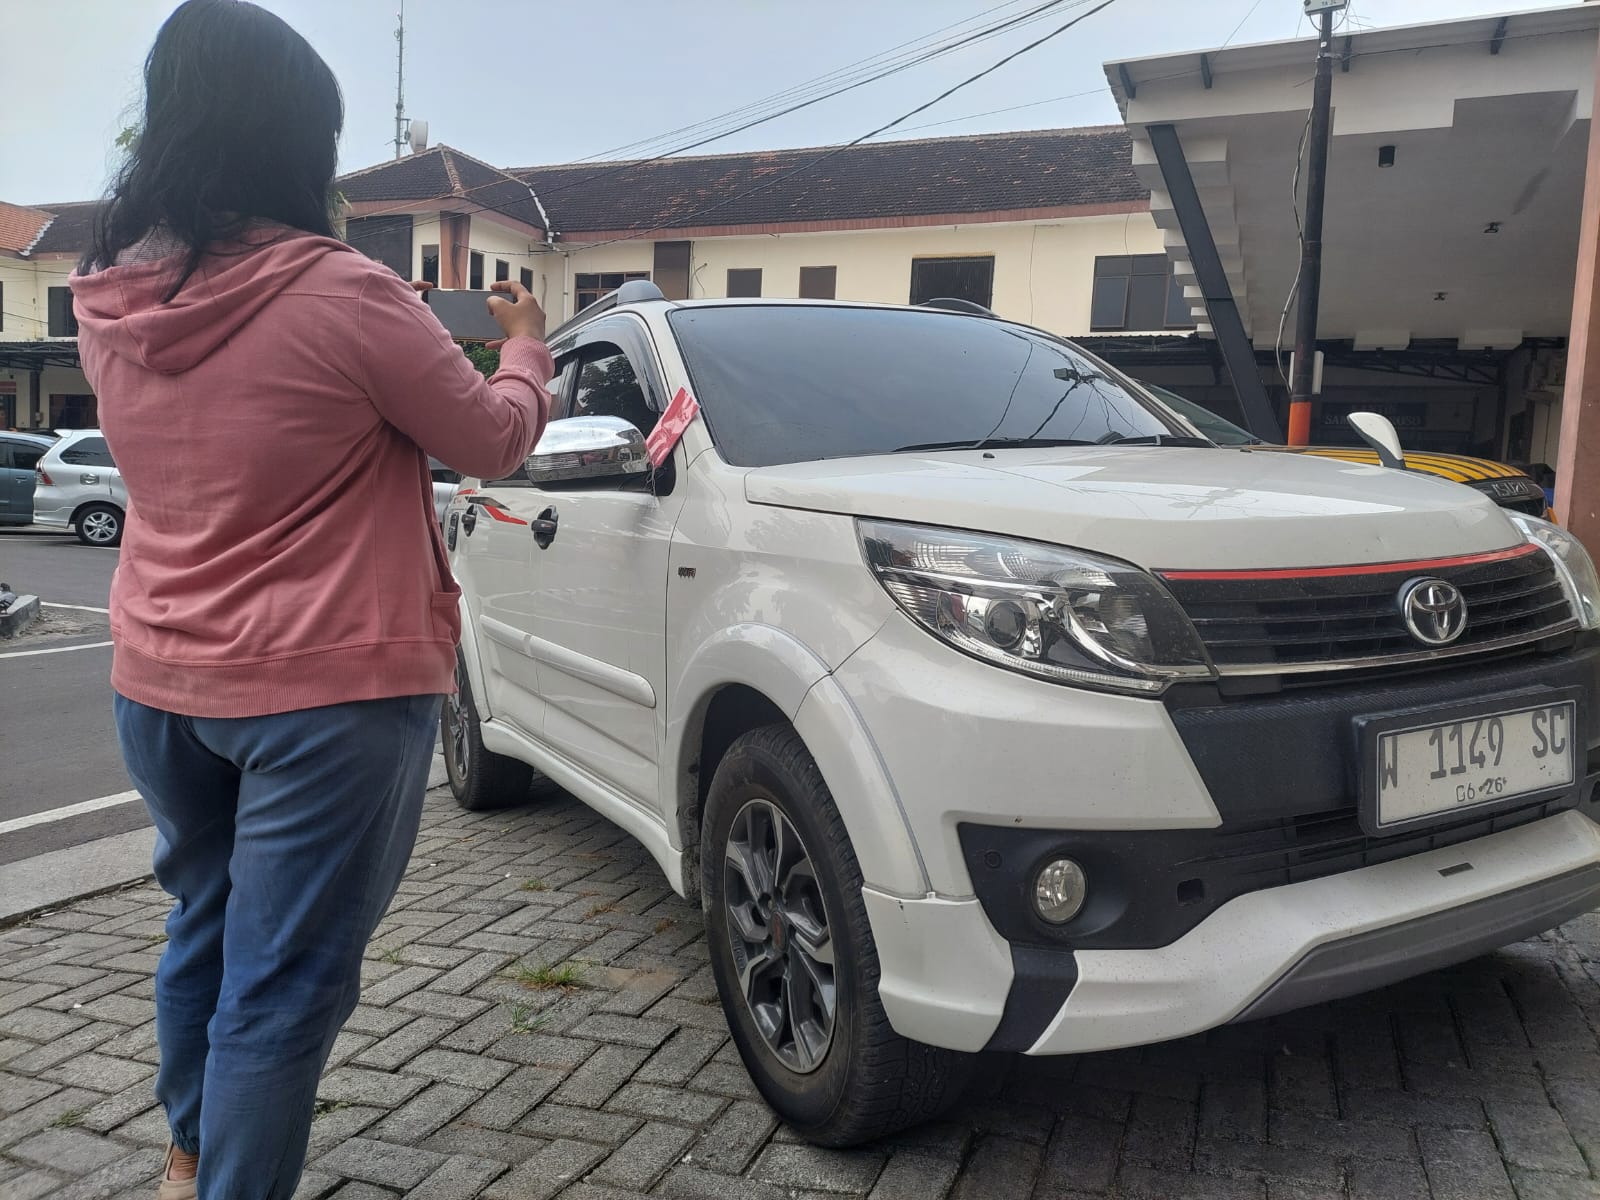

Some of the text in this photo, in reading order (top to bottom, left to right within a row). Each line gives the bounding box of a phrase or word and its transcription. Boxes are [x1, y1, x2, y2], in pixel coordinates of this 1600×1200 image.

[1381, 707, 1566, 790] W 1149 SC
